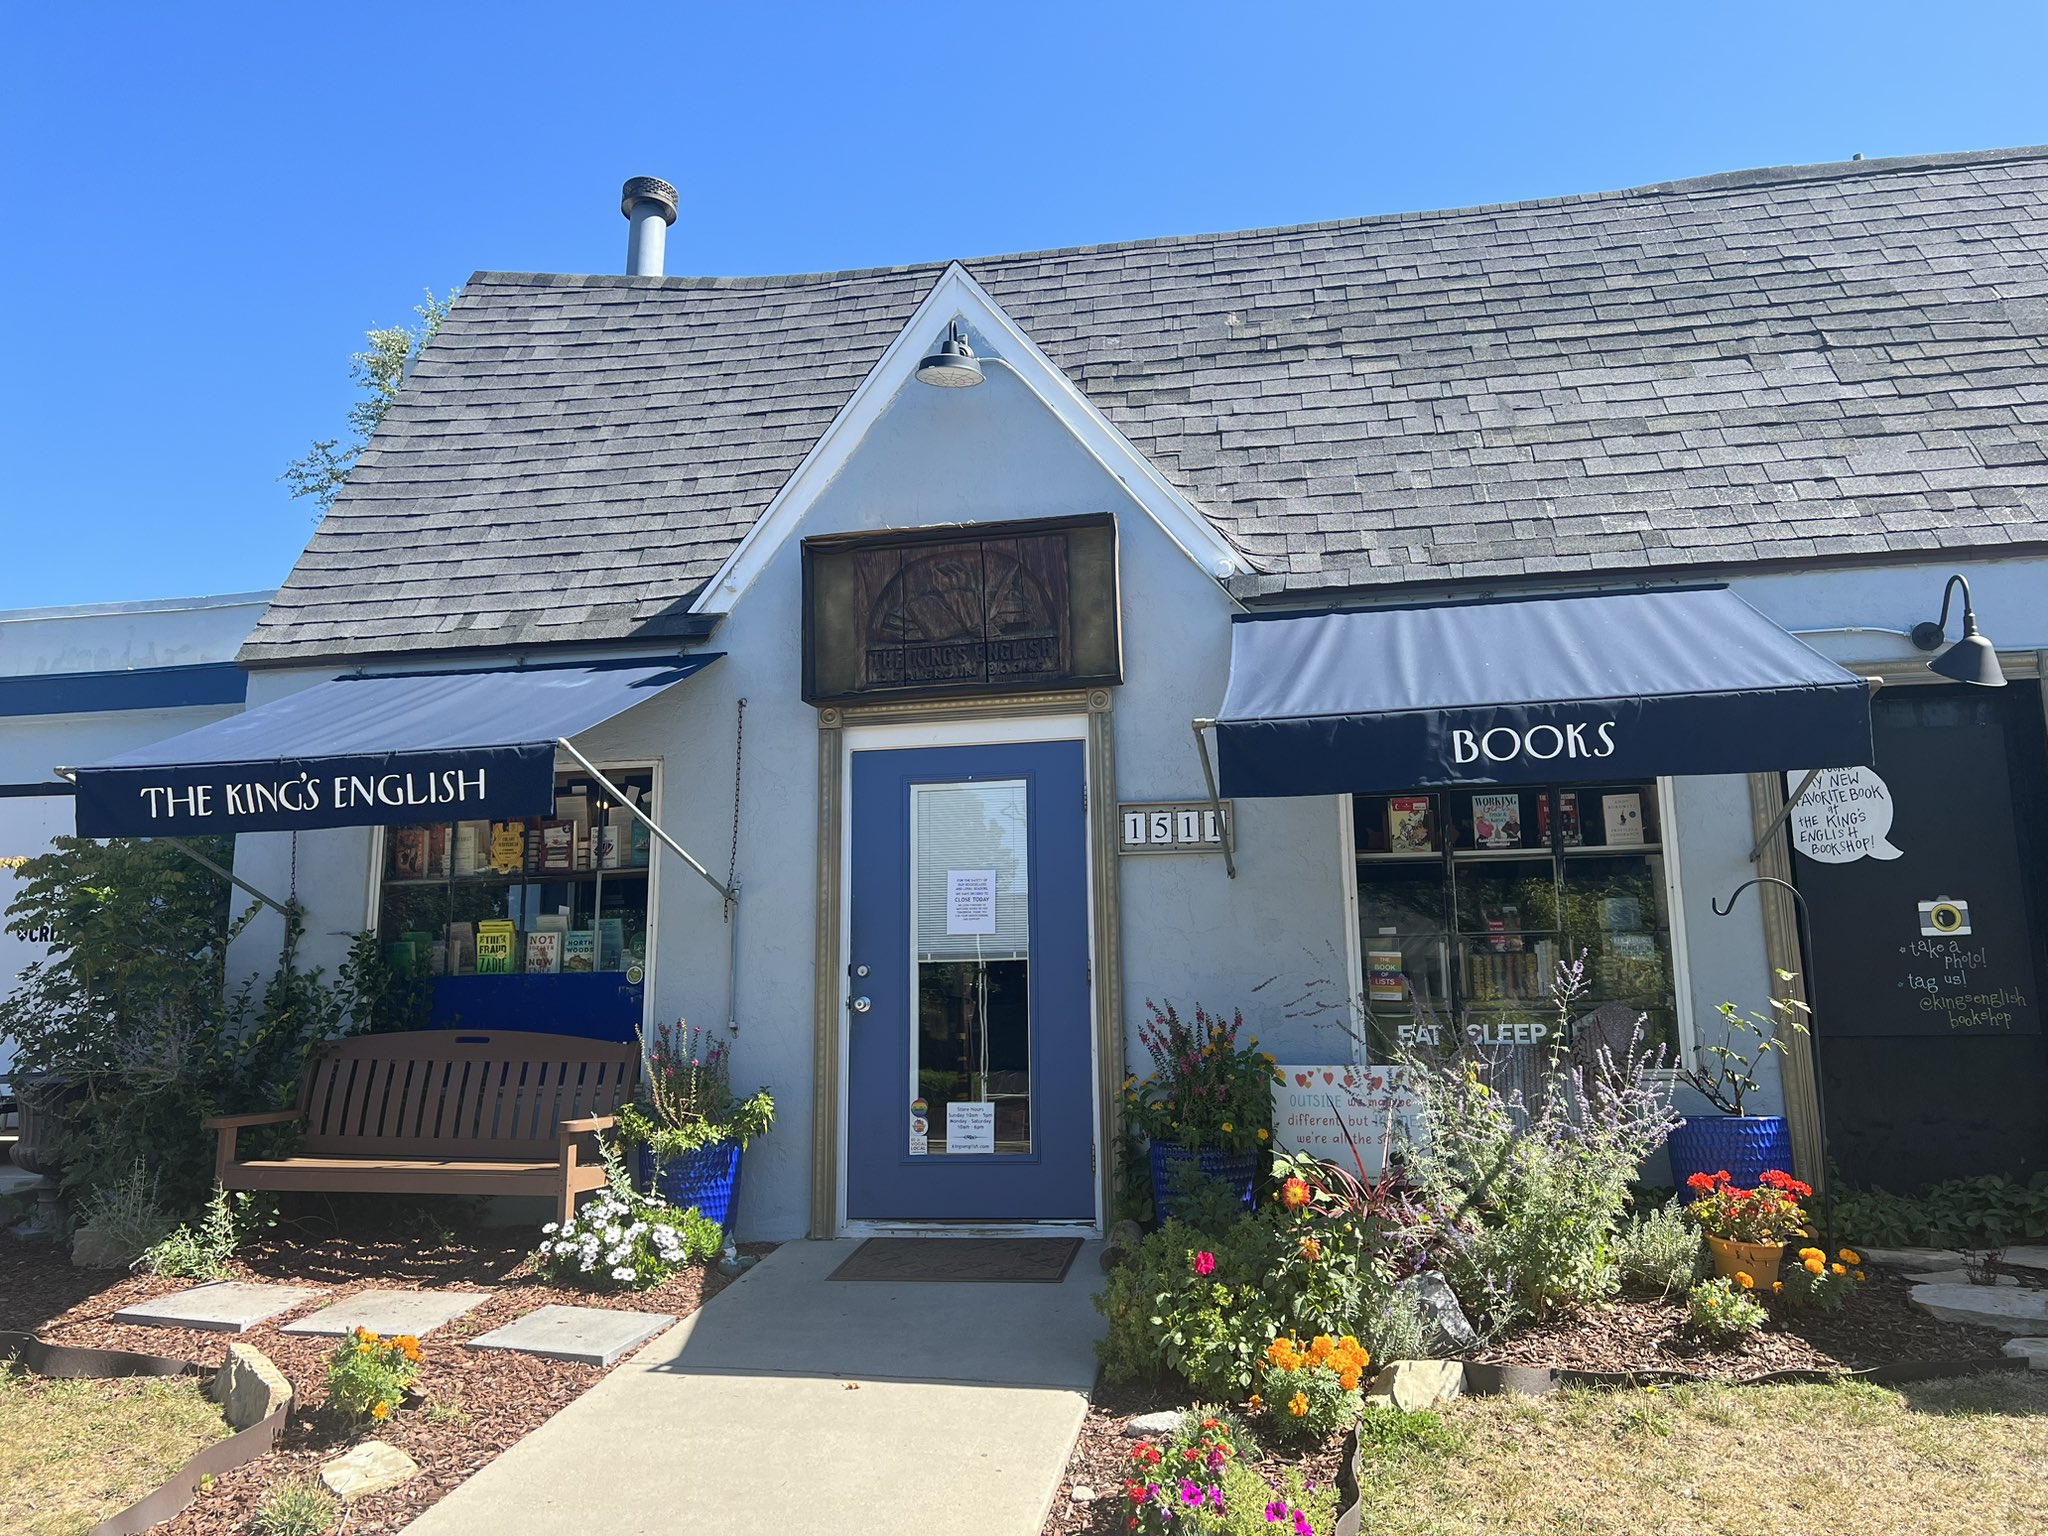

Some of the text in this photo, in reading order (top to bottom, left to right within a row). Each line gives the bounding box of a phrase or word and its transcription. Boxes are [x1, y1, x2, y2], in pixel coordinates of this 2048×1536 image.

[911, 646, 968, 667] KING'S
[975, 638, 1055, 663] ENGLISH
[1452, 721, 1616, 764] BOOKS
[1830, 772, 1859, 787] NEW
[140, 768, 486, 819] THE KING'S ENGLISH
[1849, 785, 1884, 800] BOOK
[1474, 795, 1517, 807] WORKING
[1827, 803, 1839, 815] at
[1826, 808, 1866, 828] KING'S
[1131, 816, 1222, 839] 1511
[1800, 827, 1858, 842] ENGLISH
[529, 935, 555, 944] NOT
[479, 945, 507, 954] FRAUD
[1909, 940, 1961, 958] take a
[479, 957, 506, 974] ZADIE
[528, 958, 553, 966] NOW
[1944, 947, 1987, 969] photo!
[1907, 970, 1967, 993] tag us!
[1949, 1007, 2012, 1029] bookshop
[1397, 1023, 1441, 1046] EAT
[1466, 1023, 1548, 1045] SLEEP
[1289, 1094, 1342, 1108] OUTSIDE
[1287, 1113, 1341, 1127] different
[1349, 1113, 1369, 1127] but
[1296, 1131, 1328, 1144] we're
[1353, 1131, 1372, 1145] the
